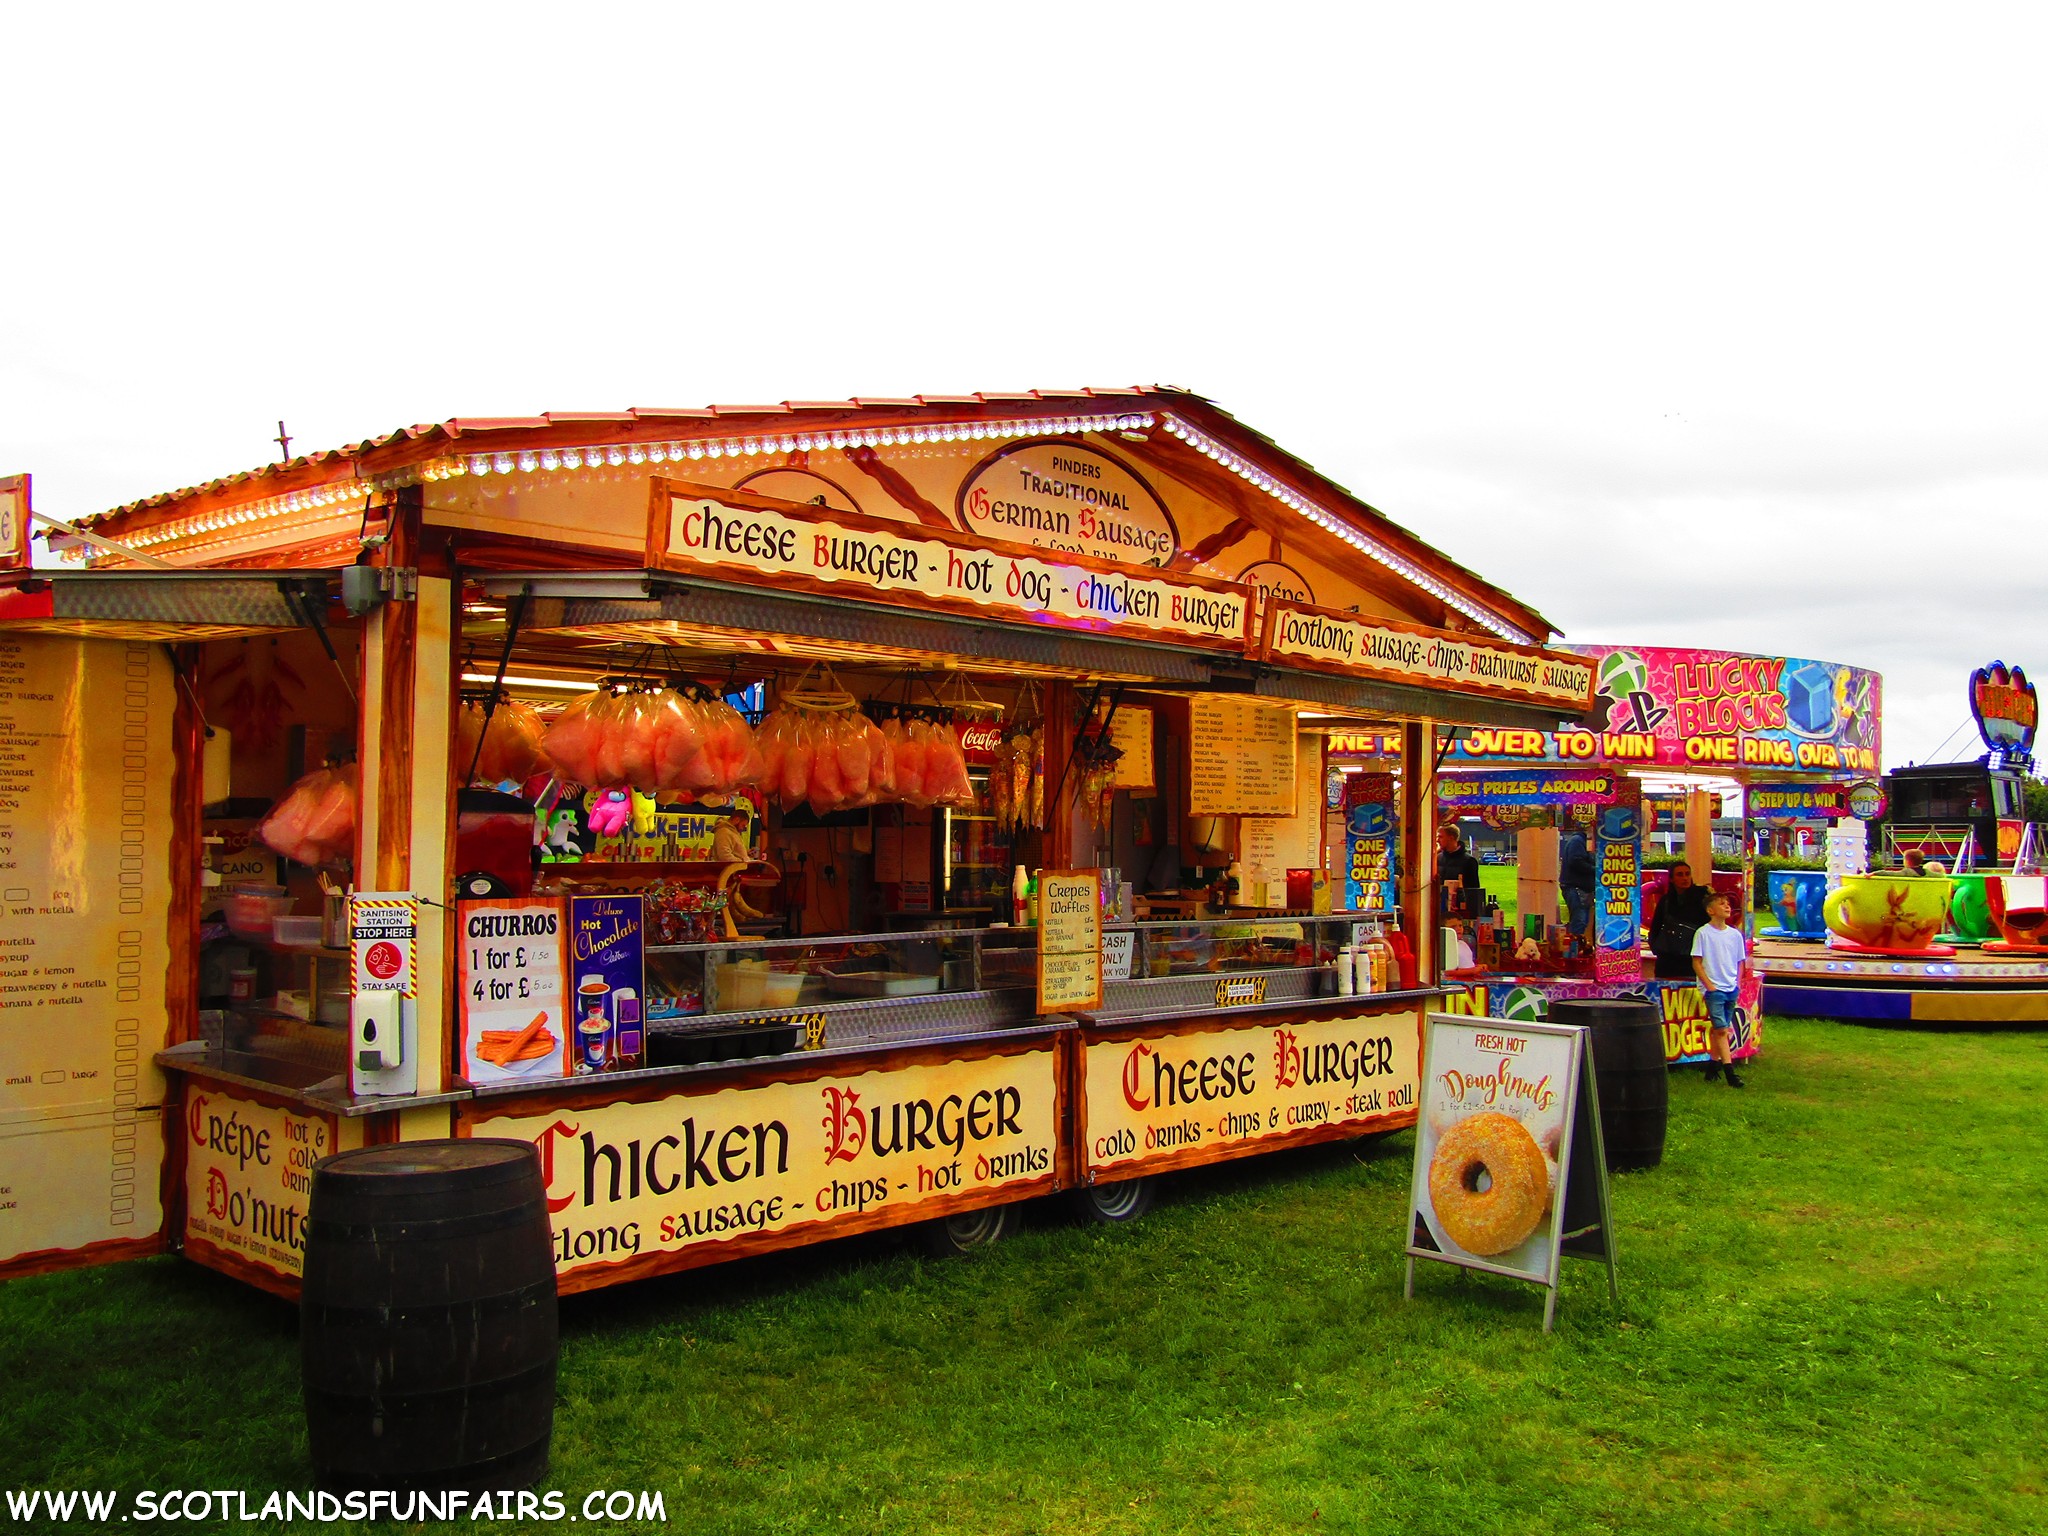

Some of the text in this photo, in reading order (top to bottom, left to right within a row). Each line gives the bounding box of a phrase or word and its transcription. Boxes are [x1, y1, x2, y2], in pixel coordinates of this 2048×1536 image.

[1053, 456, 1101, 479] PINDERS
[1020, 470, 1129, 511] TRADITIONAL
[947, 549, 993, 593] hot
[1005, 560, 1051, 609] dog
[1674, 657, 1784, 700] LUCKY
[1675, 692, 1786, 740] BLOCKS
[1464, 730, 1544, 756] OVER
[1555, 732, 1595, 757] TO
[1602, 733, 1656, 758] WIN
[1686, 738, 1874, 769] ONE RING OVER TO WIN
[1444, 780, 1607, 796] BEST PRIZES AROUND
[1760, 792, 1784, 808] STEP
[1785, 793, 1800, 807] UP
[1803, 792, 1812, 807] &
[1814, 792, 1836, 807] WIN
[1850, 801, 1879, 813] WIN
[1355, 840, 1385, 852] ONE
[1604, 844, 1632, 856] ONE
[1353, 854, 1387, 866] RING
[1603, 859, 1634, 871] RING
[1351, 868, 1388, 880] OVER
[1601, 873, 1635, 885] OVER
[1048, 883, 1090, 900] Crepes
[1360, 882, 1380, 894] TO
[1610, 887, 1628, 900] TO
[592, 900, 623, 916] Deluxe
[1050, 901, 1090, 914] Waffles
[1356, 896, 1383, 908] WIN
[1606, 902, 1631, 914] WIN
[11, 906, 74, 915] with nutella
[360, 909, 409, 918] SANITISING
[366, 918, 403, 926] STATION
[468, 914, 557, 938] CHURROS
[581, 920, 601, 930] Hot
[356, 927, 412, 938] STOP HERE
[574, 917, 639, 961] Chocolate
[1101, 936, 1126, 948] CASH
[472, 949, 478, 970] 1
[486, 949, 510, 969] for
[1599, 950, 1636, 963] LUCKY
[44, 966, 75, 975] lemon
[1115, 968, 1128, 976] YOU
[1600, 961, 1639, 977] BLOCKS
[73, 981, 107, 989] nutella
[385, 982, 406, 990] SAFE
[473, 980, 484, 1001] 4
[489, 979, 513, 1000] for
[1475, 1034, 1527, 1053] FRESH HOT
[6, 1076, 32, 1085] small
[1437, 1058, 1558, 1111] Doughnuts
[284, 1117, 308, 1144] hot
[316, 1127, 325, 1147] &
[1145, 1119, 1201, 1150] drinks
[1269, 1108, 1279, 1127] &
[282, 1166, 311, 1195] drin
[551, 1222, 640, 1263] tlong
[917, 1160, 961, 1193] hot
[975, 1145, 1048, 1181] drinks
